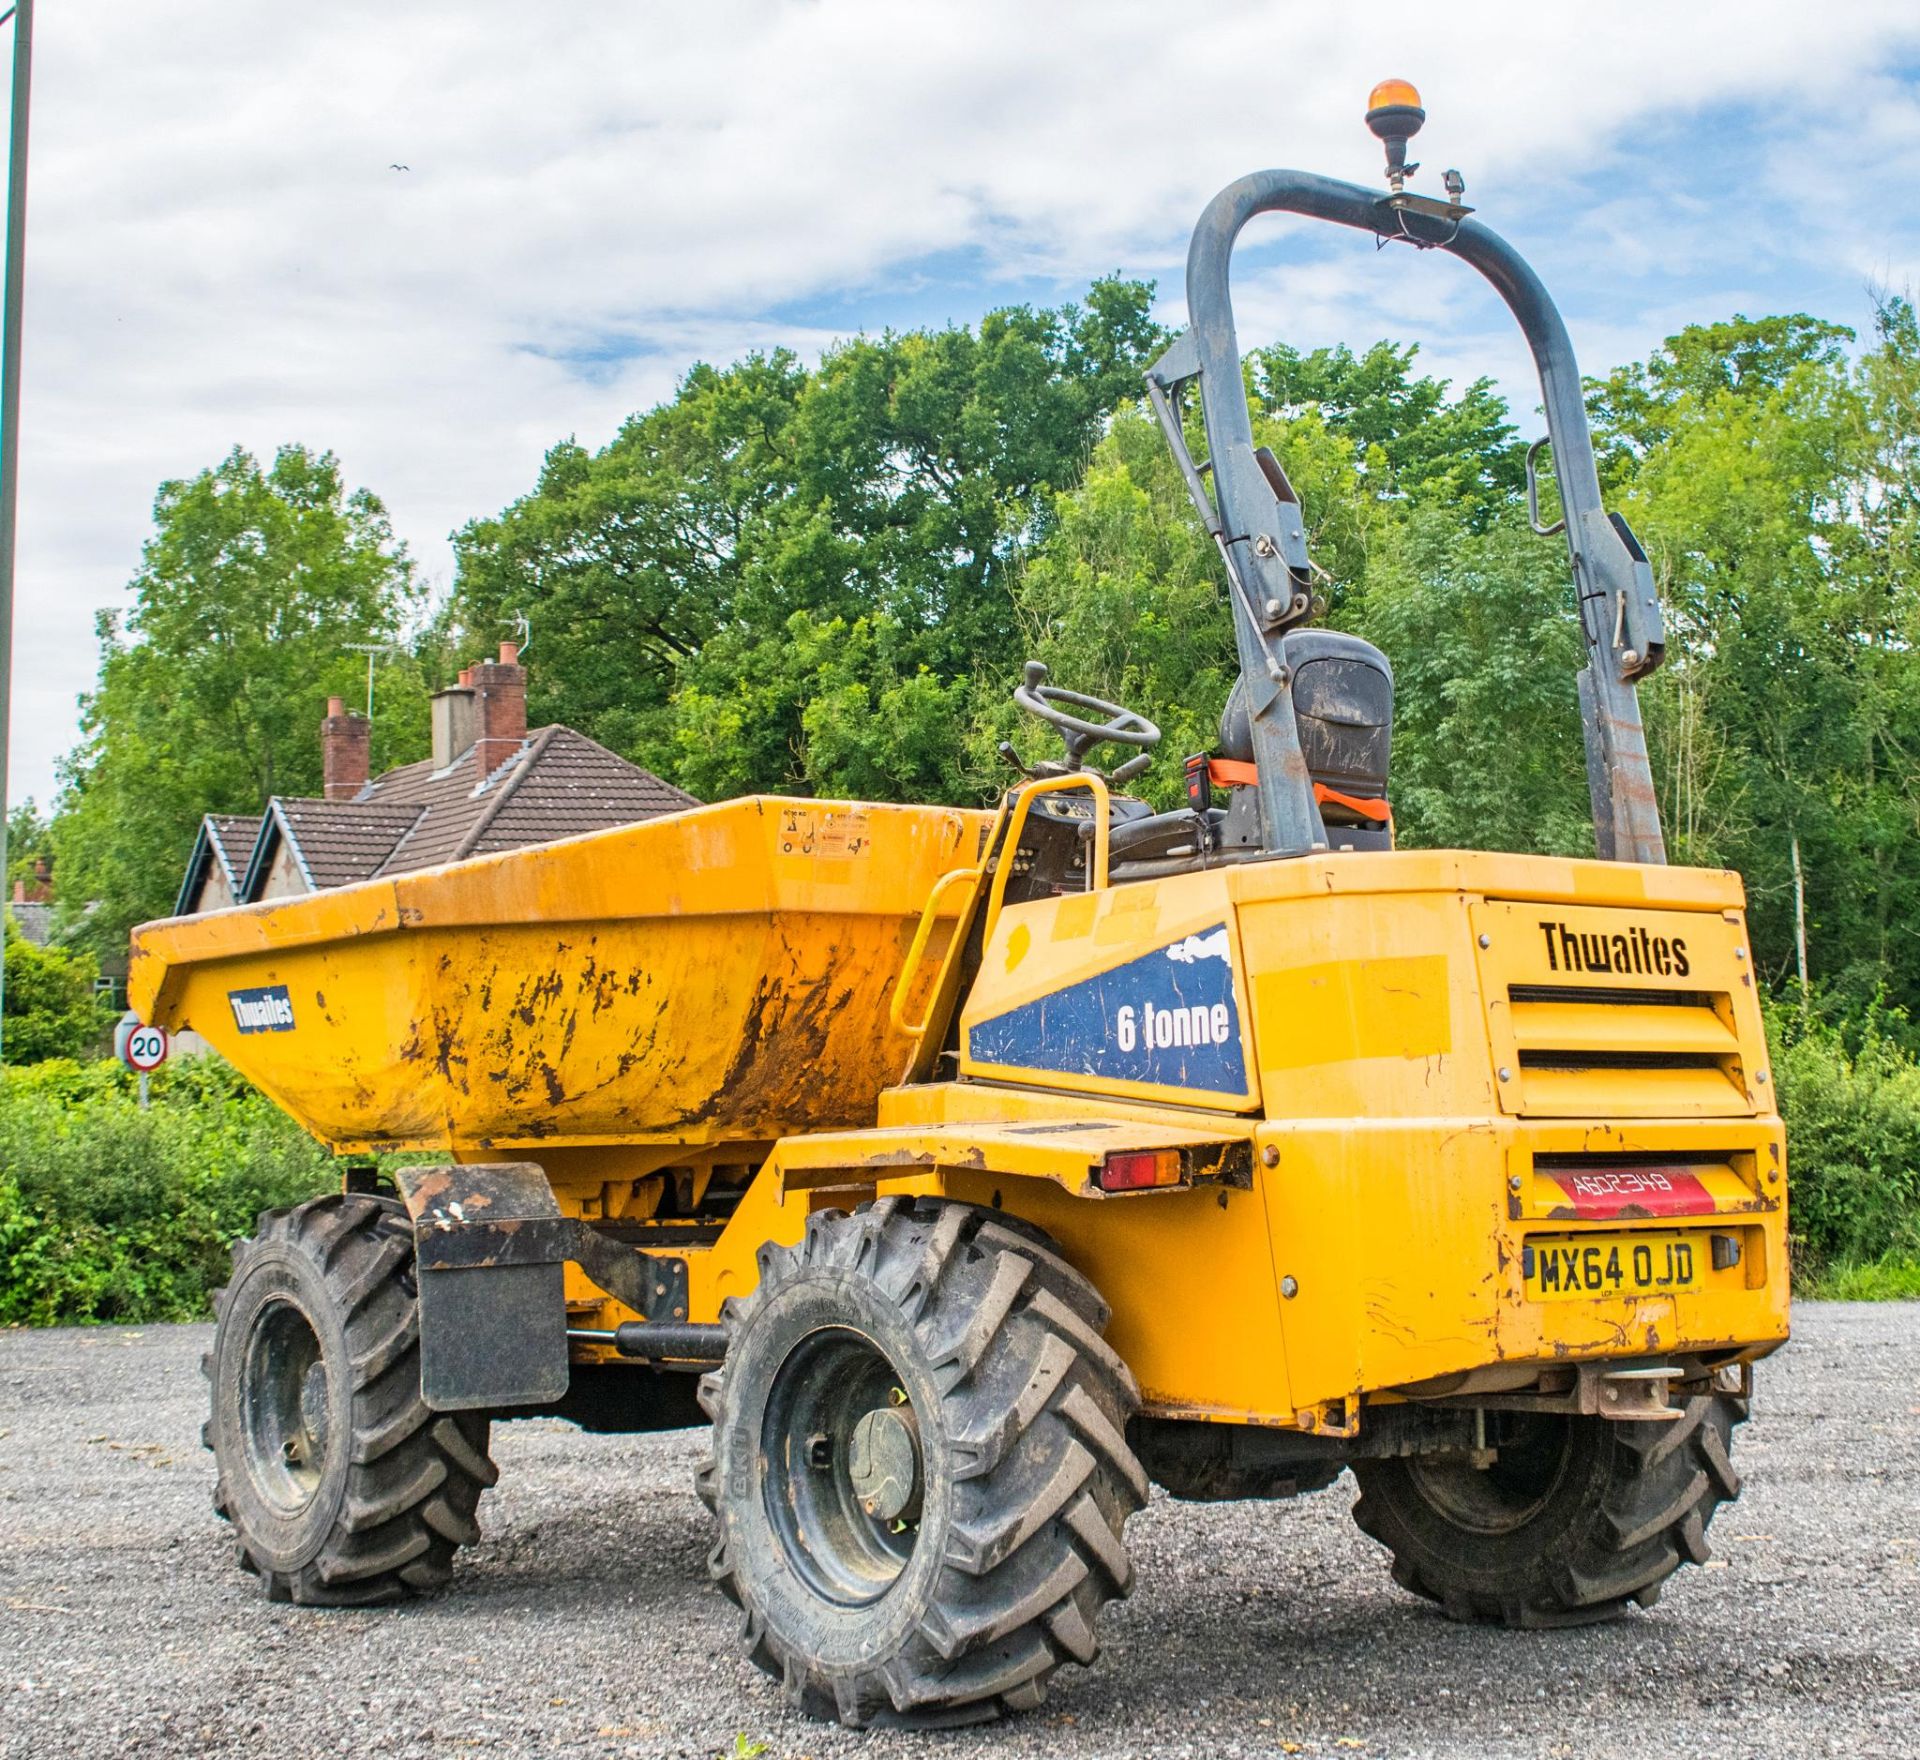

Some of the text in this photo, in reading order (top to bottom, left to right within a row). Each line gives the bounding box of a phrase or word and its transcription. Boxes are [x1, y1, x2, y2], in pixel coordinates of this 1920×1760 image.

[1538, 921, 1690, 977] Thwaites
[230, 994, 293, 1027] Thwaites
[1117, 1002, 1229, 1052] 6 tonne
[132, 1036, 161, 1057] 20
[1539, 1243, 1693, 1293] MX64 OJD
